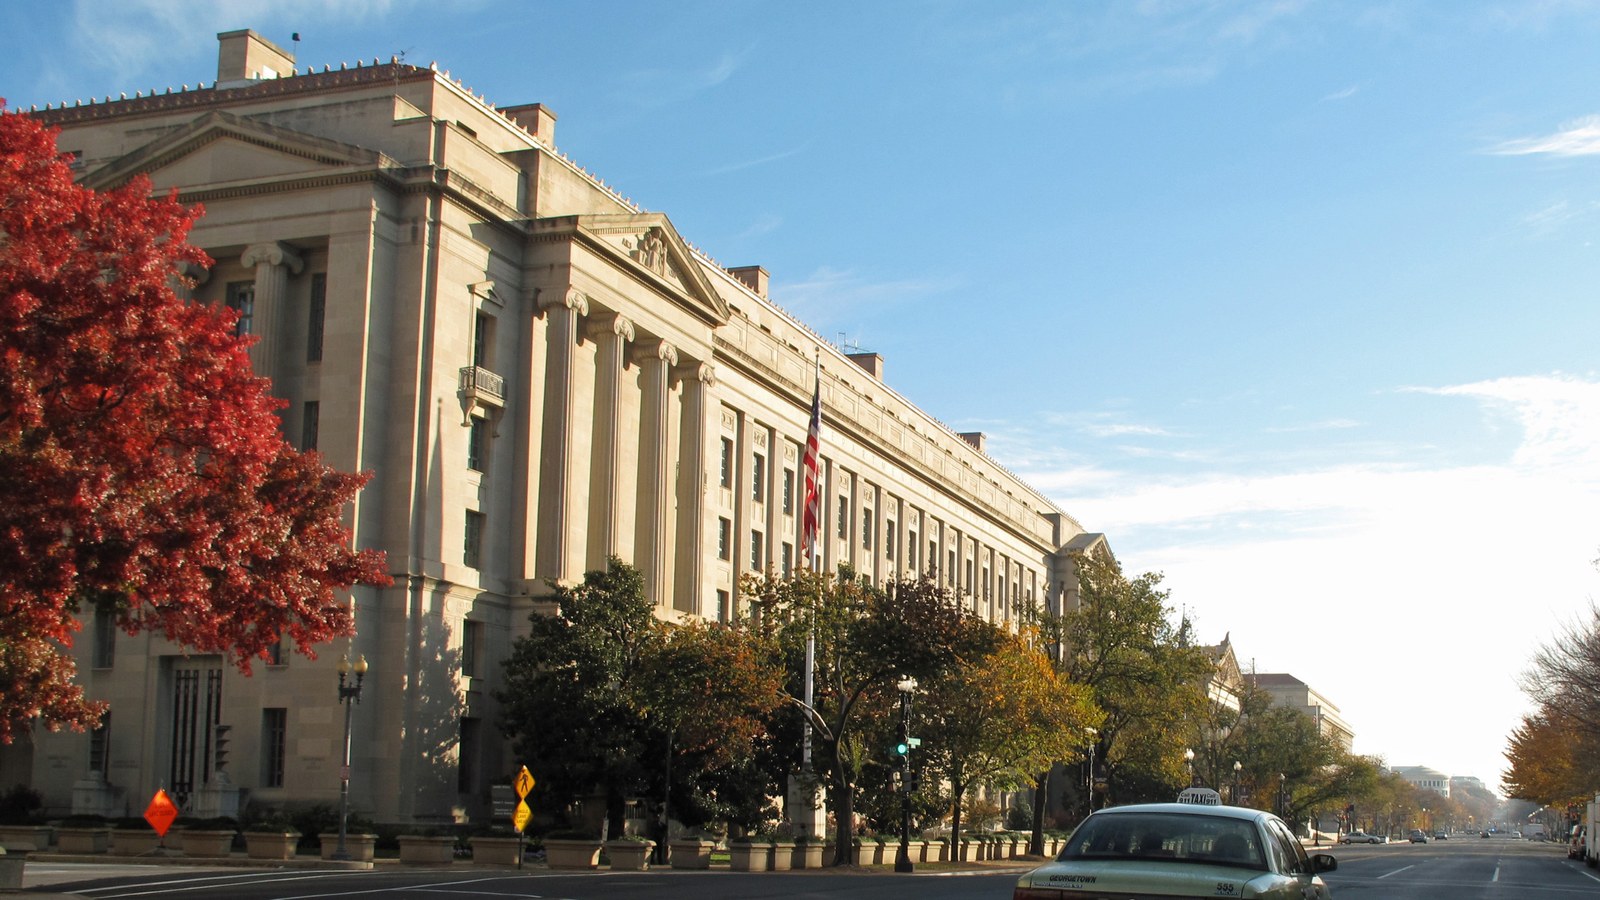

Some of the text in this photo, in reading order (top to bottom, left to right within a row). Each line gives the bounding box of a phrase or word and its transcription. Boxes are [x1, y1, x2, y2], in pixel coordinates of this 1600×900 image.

[1191, 793, 1206, 804] TAXI
[1049, 874, 1097, 884] GEORGETOWN
[1216, 882, 1234, 893] 555
